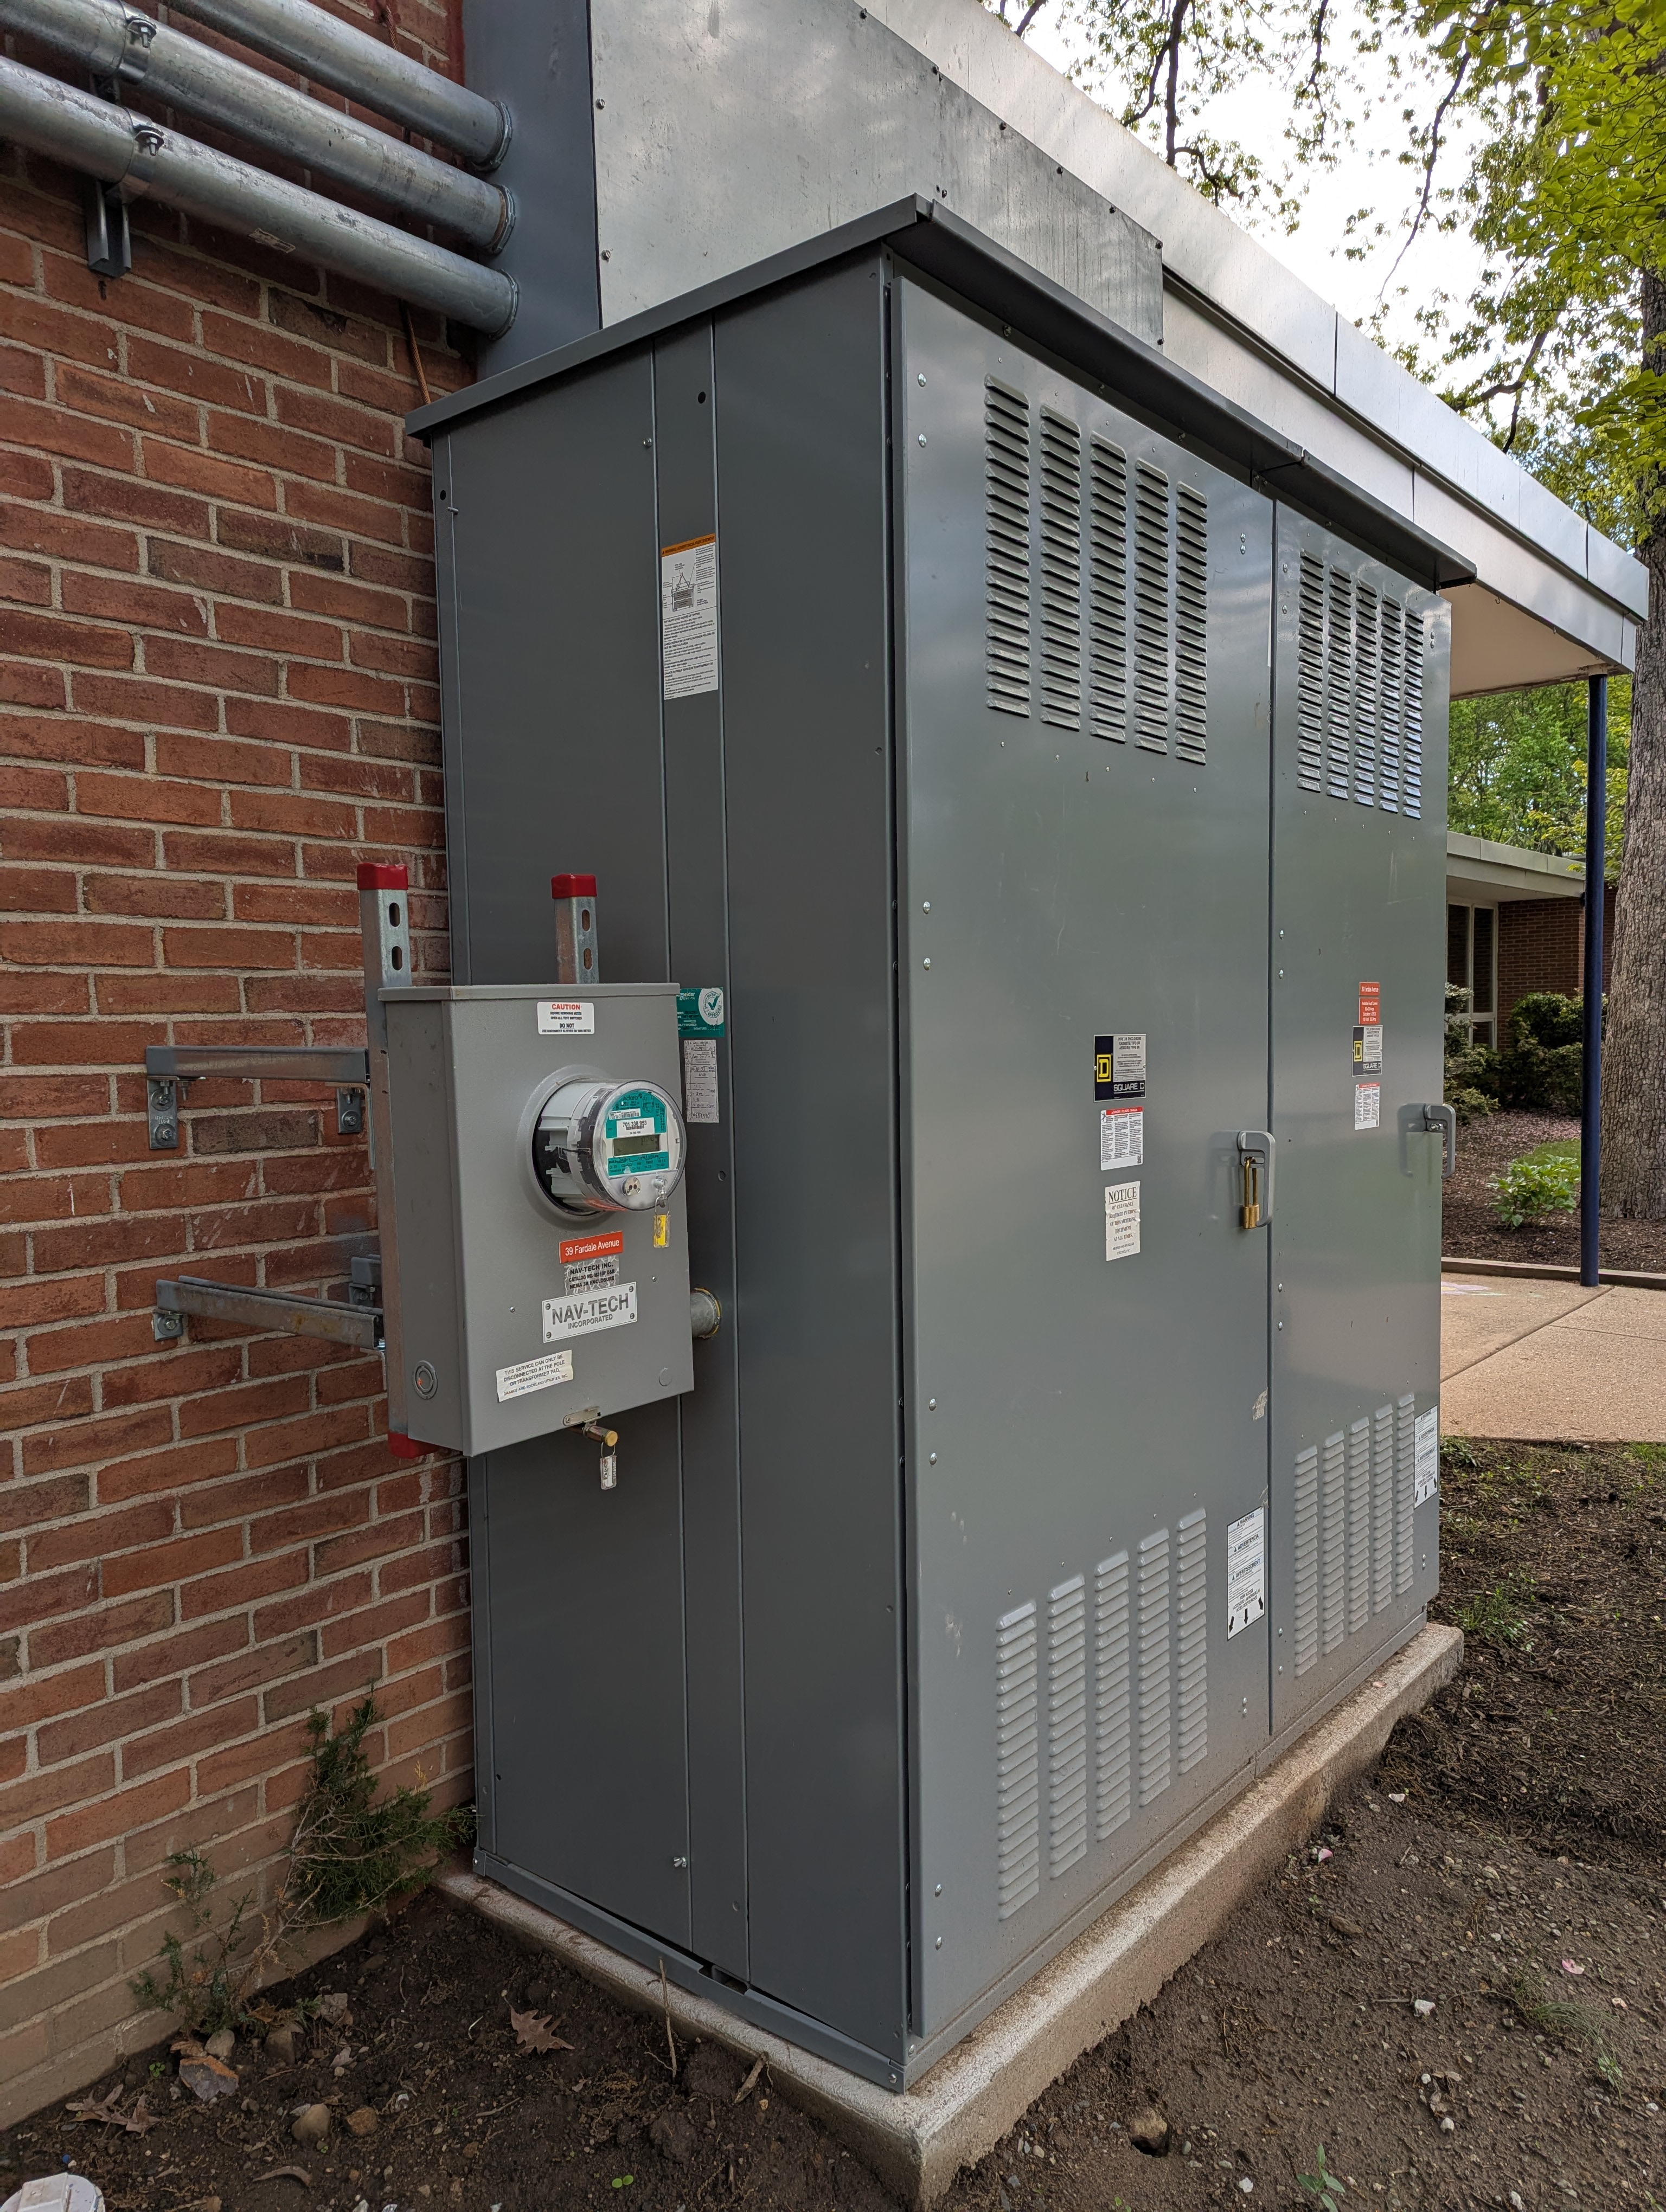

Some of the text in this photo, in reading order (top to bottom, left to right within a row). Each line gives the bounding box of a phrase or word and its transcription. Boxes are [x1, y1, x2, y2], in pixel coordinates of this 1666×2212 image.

[1113, 1083, 1138, 1091] SQUARE
[1108, 1187, 1137, 1203] NOTICE
[565, 1239, 619, 1256] 39 Fardale Avenue
[570, 1264, 600, 1275] NAV-TECH
[569, 1275, 586, 1283] CATALOG
[589, 1276, 614, 1285] ENCLOSURE
[552, 1293, 629, 1325] NAV-TECH
[568, 1314, 613, 1329] INCORPORATED
[503, 1367, 537, 1382] DISCONNECTED
[516, 1362, 534, 1372] SERVICE
[517, 1370, 550, 1385] TRANSFORMER
[526, 1380, 544, 1388] ROCKLAND
[1240, 1513, 1254, 1525] WARNING
[1238, 1533, 1259, 1550] ADVERTENCIA
[1235, 1558, 1261, 1578] AVERTISSEMENT
